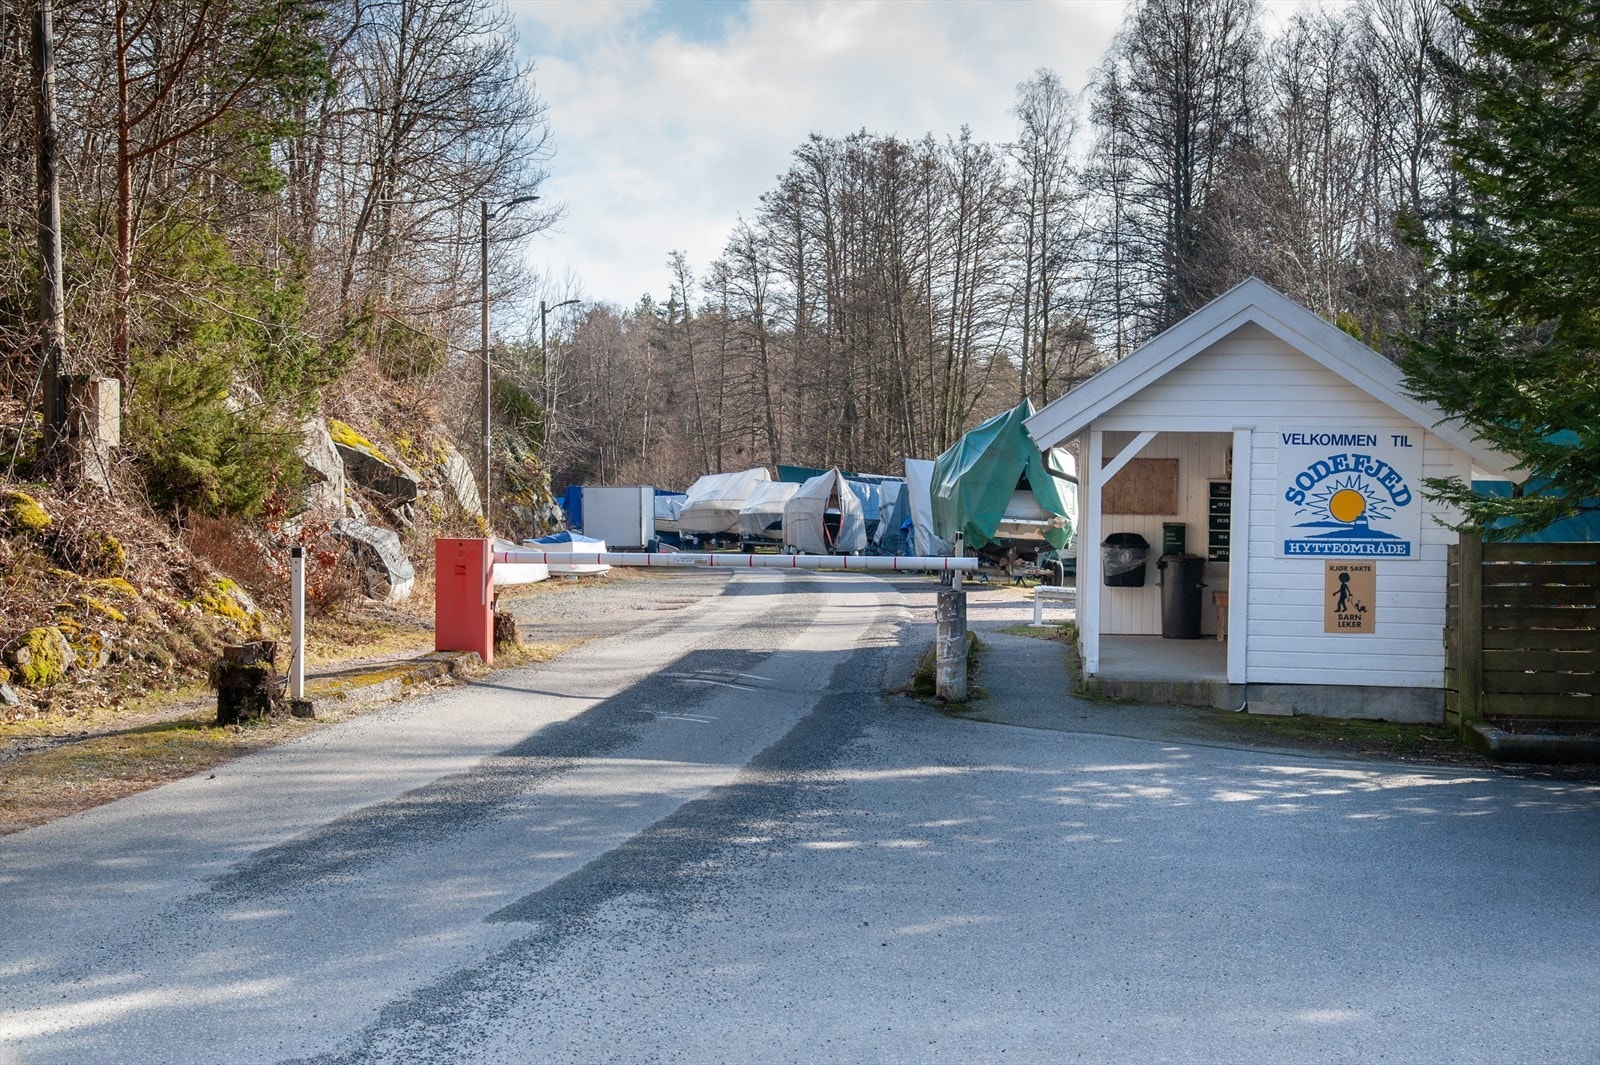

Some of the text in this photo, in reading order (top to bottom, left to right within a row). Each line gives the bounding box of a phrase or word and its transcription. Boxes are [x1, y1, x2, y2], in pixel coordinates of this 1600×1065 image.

[1282, 433, 1413, 447] VELKOMMEN TIL
[1285, 453, 1412, 507] SODEFJED
[1289, 542, 1406, 554] HYTTEOMRÅDE
